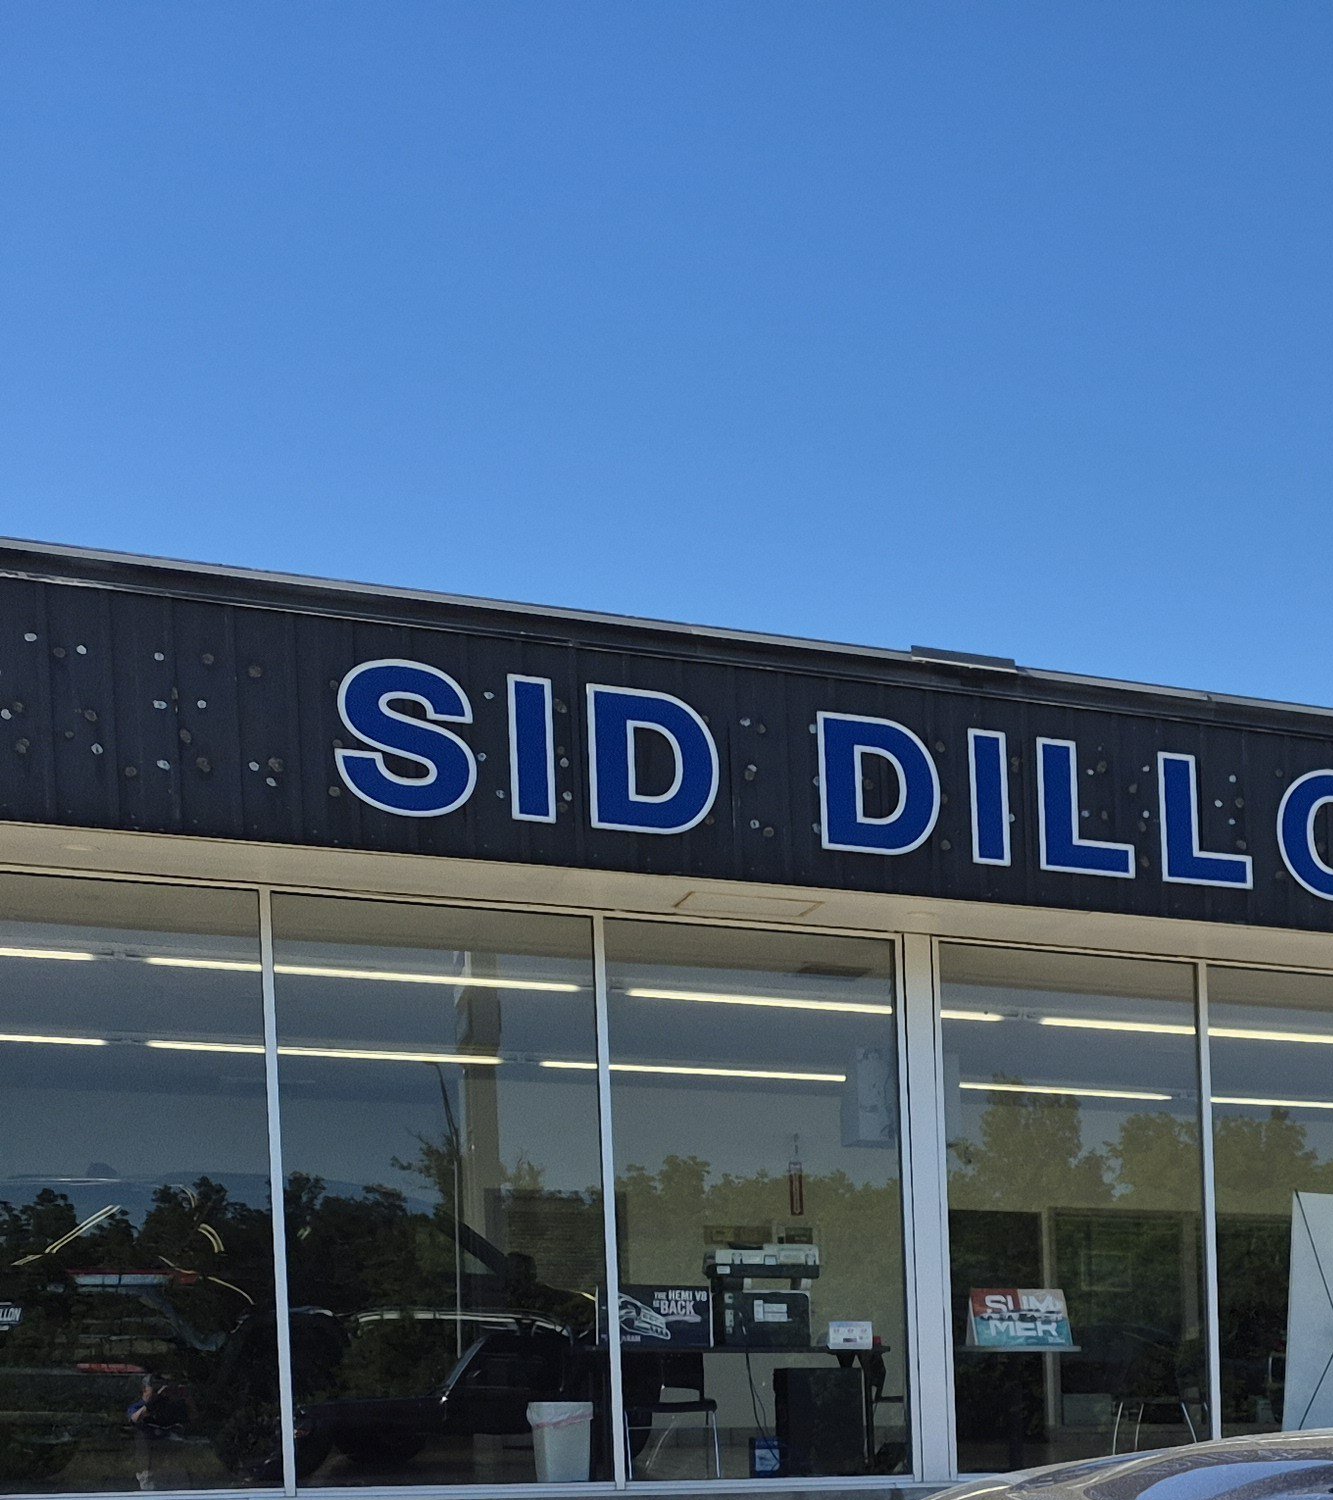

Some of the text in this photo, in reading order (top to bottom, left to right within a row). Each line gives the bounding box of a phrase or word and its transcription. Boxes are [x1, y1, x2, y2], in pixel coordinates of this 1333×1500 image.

[334, 658, 721, 835] SID
[654, 1289, 708, 1302] THE HEMI V8
[660, 1300, 696, 1316] BACK
[988, 1319, 1059, 1337] MER
